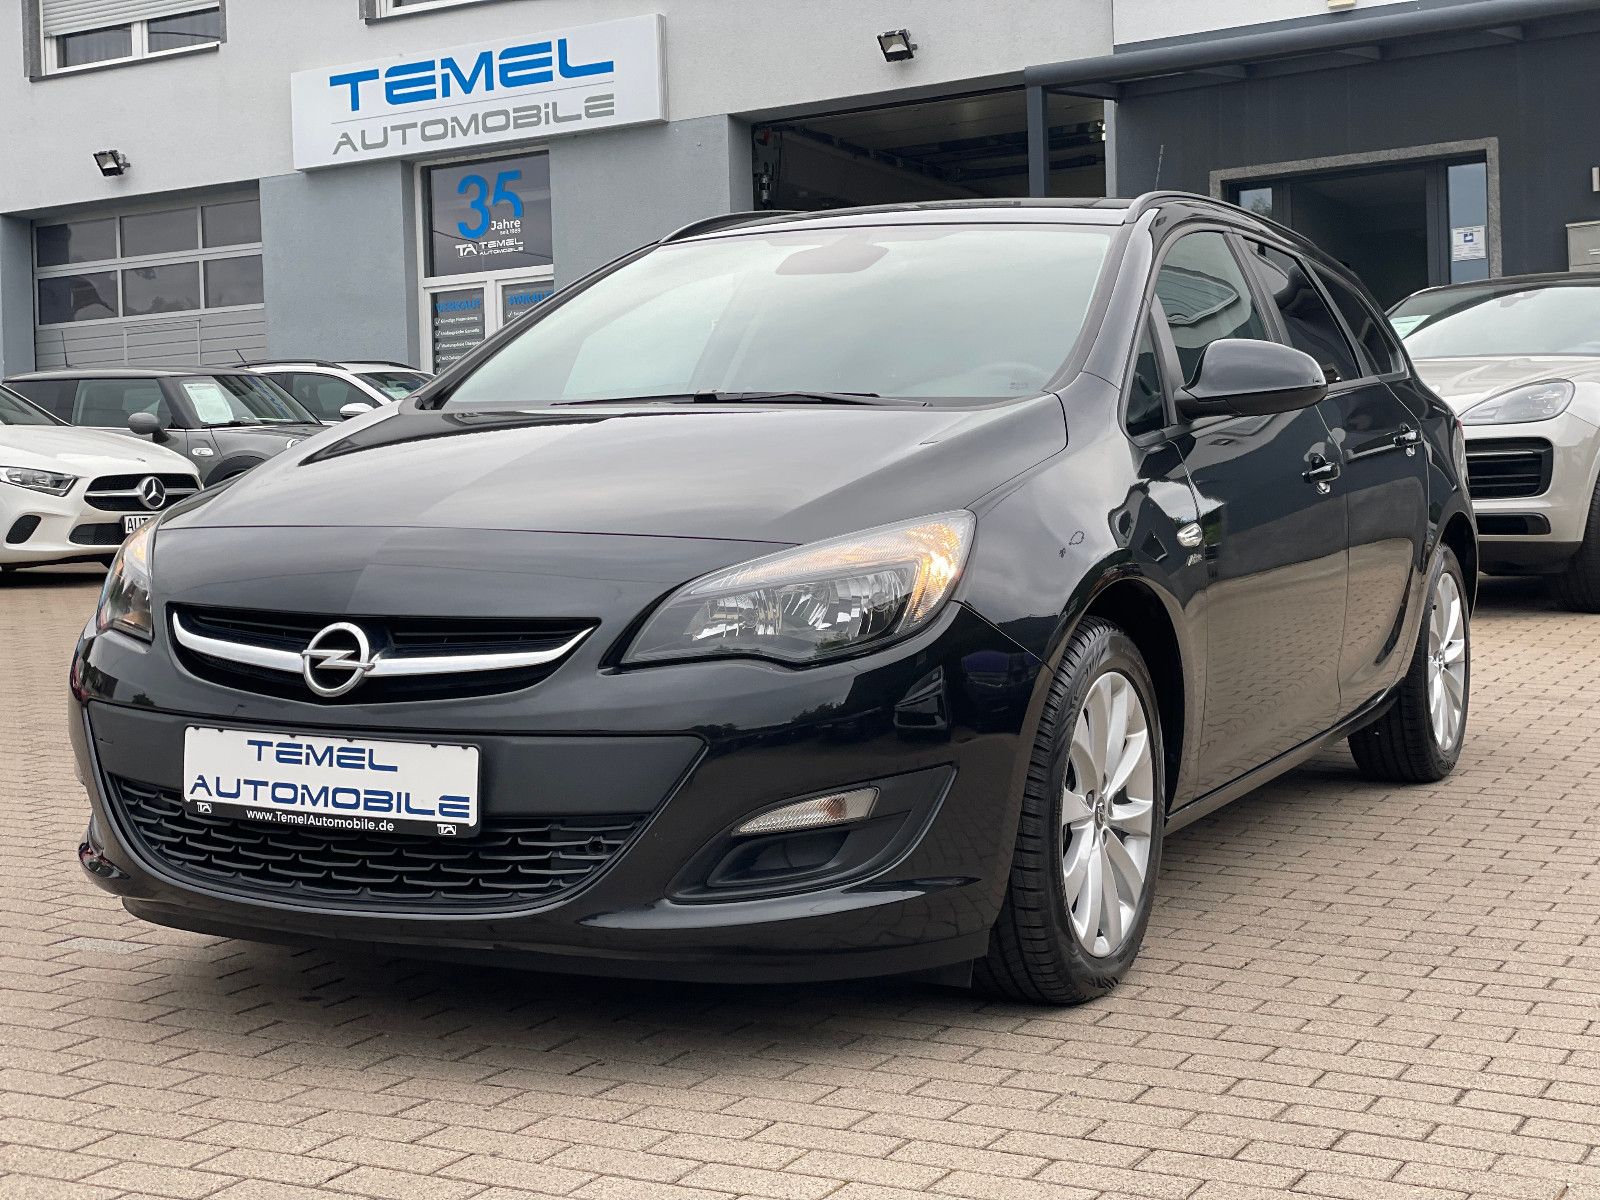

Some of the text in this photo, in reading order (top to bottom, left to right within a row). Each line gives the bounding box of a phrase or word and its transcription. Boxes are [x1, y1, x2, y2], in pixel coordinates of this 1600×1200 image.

[330, 38, 614, 112] TEMEL
[457, 169, 524, 239] 35
[490, 219, 521, 231] Jahre
[478, 238, 524, 249] TEMEL
[247, 739, 398, 772] TEMEL
[189, 774, 470, 819] AUTOMOBILE
[245, 808, 395, 832] www.TemelAutomobile.de
